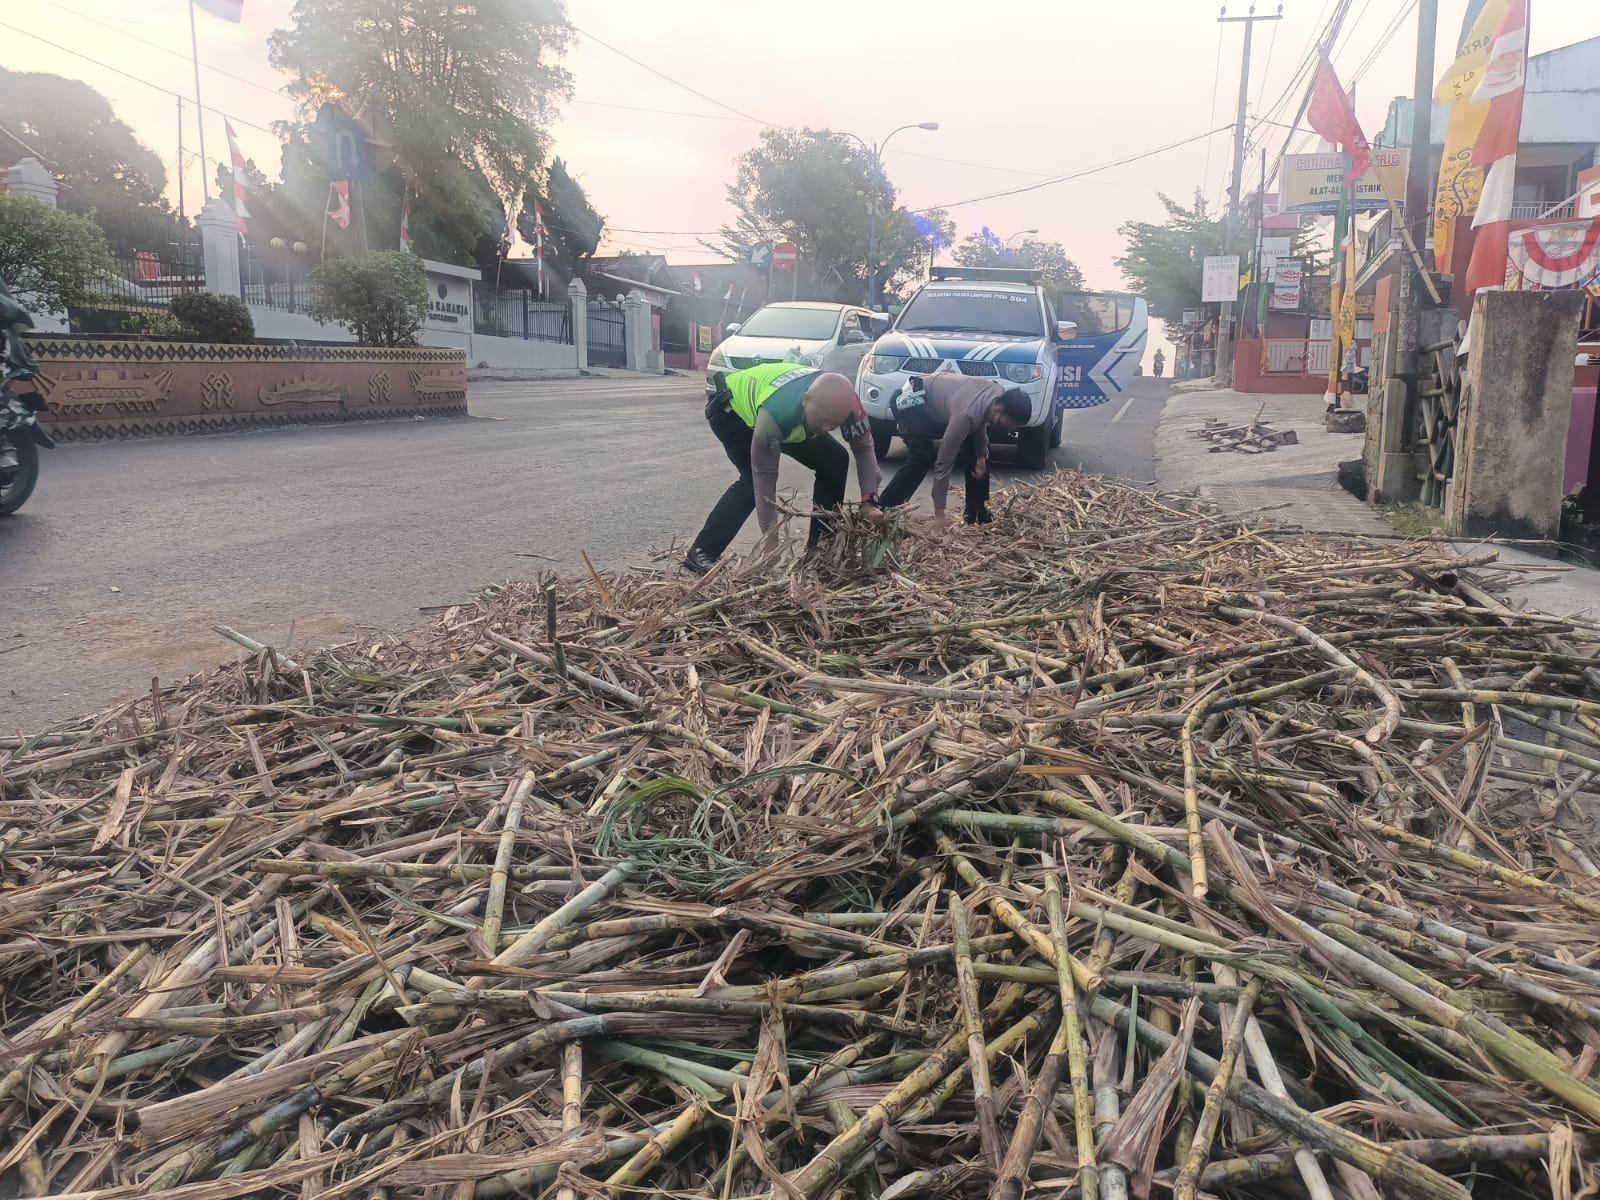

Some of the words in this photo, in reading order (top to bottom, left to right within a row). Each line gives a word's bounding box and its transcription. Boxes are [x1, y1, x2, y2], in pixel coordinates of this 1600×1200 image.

[1296, 157, 1342, 170] CANDRA
[1309, 186, 1344, 196] ALAT-AL
[1356, 183, 1382, 193] ISTRIK
[1010, 295, 1027, 303] 504
[1057, 365, 1082, 382] ISI
